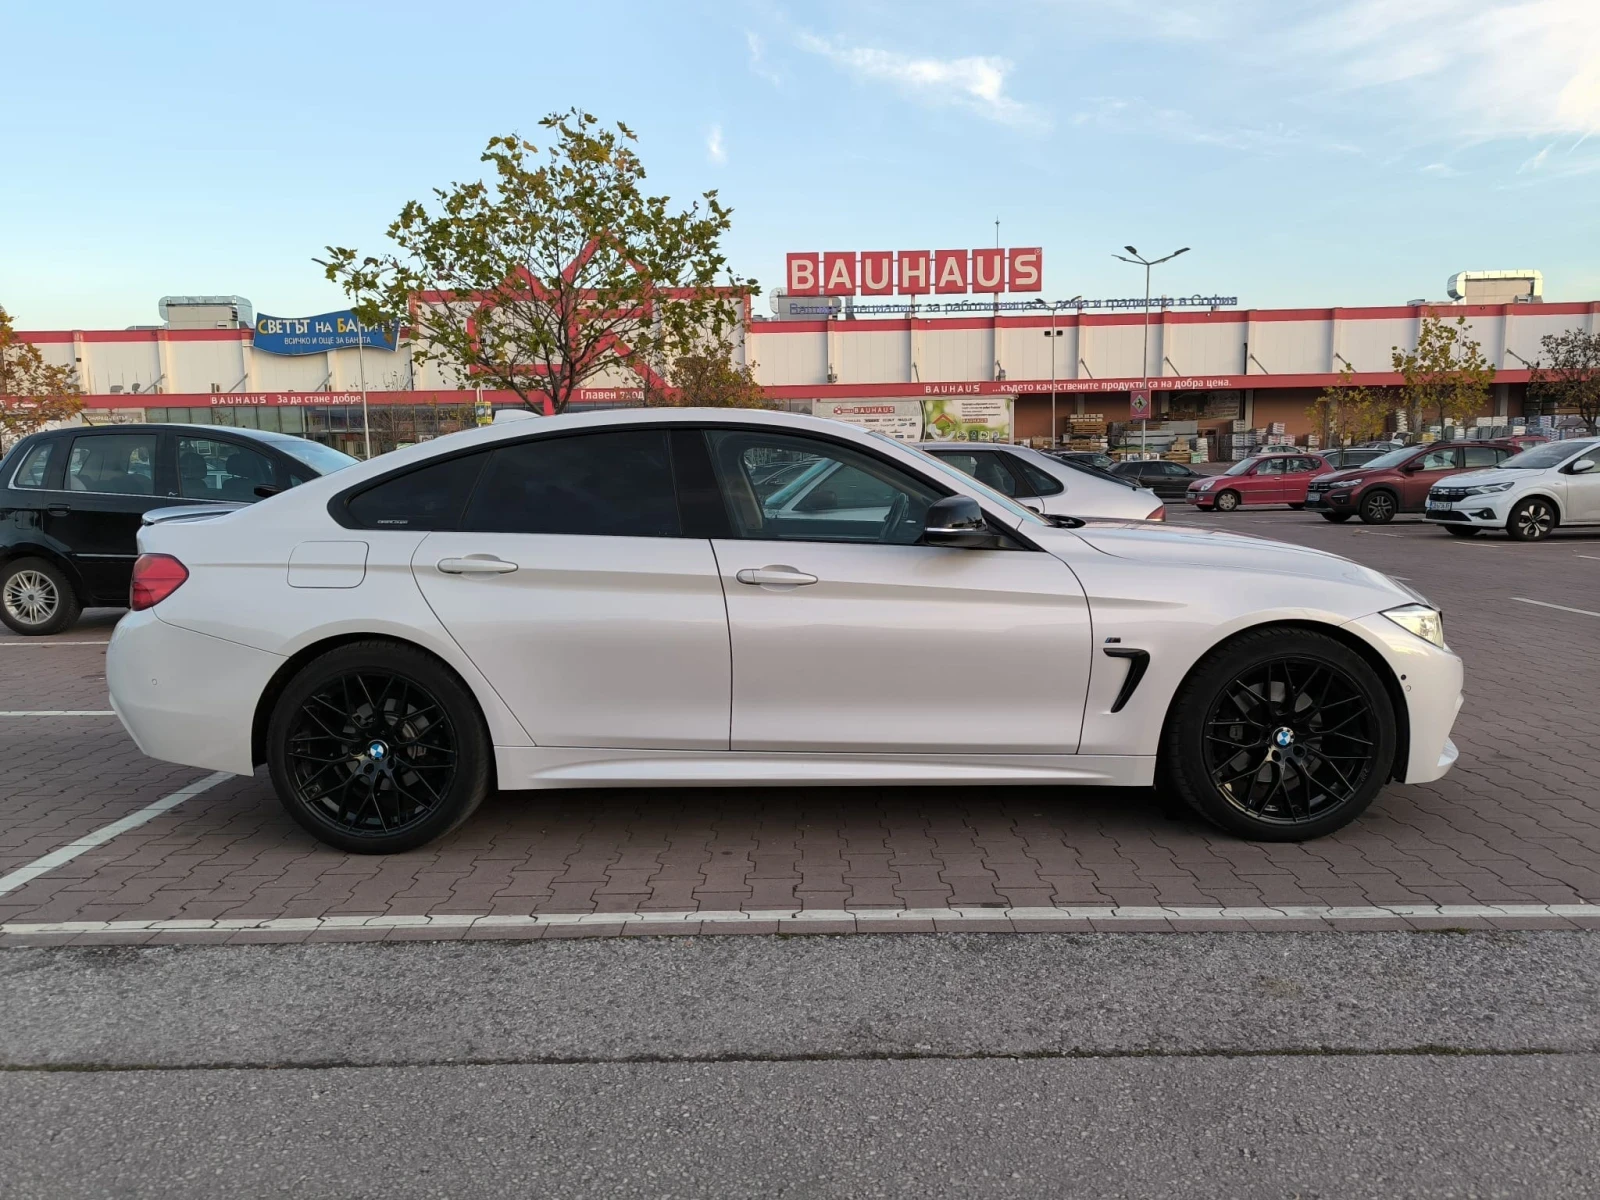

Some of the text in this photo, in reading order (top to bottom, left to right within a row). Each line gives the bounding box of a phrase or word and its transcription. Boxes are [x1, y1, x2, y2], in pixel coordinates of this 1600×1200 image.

[791, 254, 1039, 290] BAUHAUS
[258, 319, 310, 334] СВЕТЪТ
[315, 322, 332, 333] НА
[285, 337, 310, 345] ВСИЧКО
[319, 337, 334, 345] ОЩЕ
[346, 336, 371, 344] БАНТА
[925, 384, 980, 394] BAUHAUS
[1036, 381, 1098, 391] качествените
[1101, 381, 1145, 391] продукти
[1175, 378, 1204, 389] добра
[1207, 379, 1232, 389] цена.
[211, 395, 267, 404] BAUHAUS
[277, 394, 288, 403] За
[290, 395, 301, 405] да
[304, 395, 330, 403] стане
[580, 390, 616, 400] Главен
